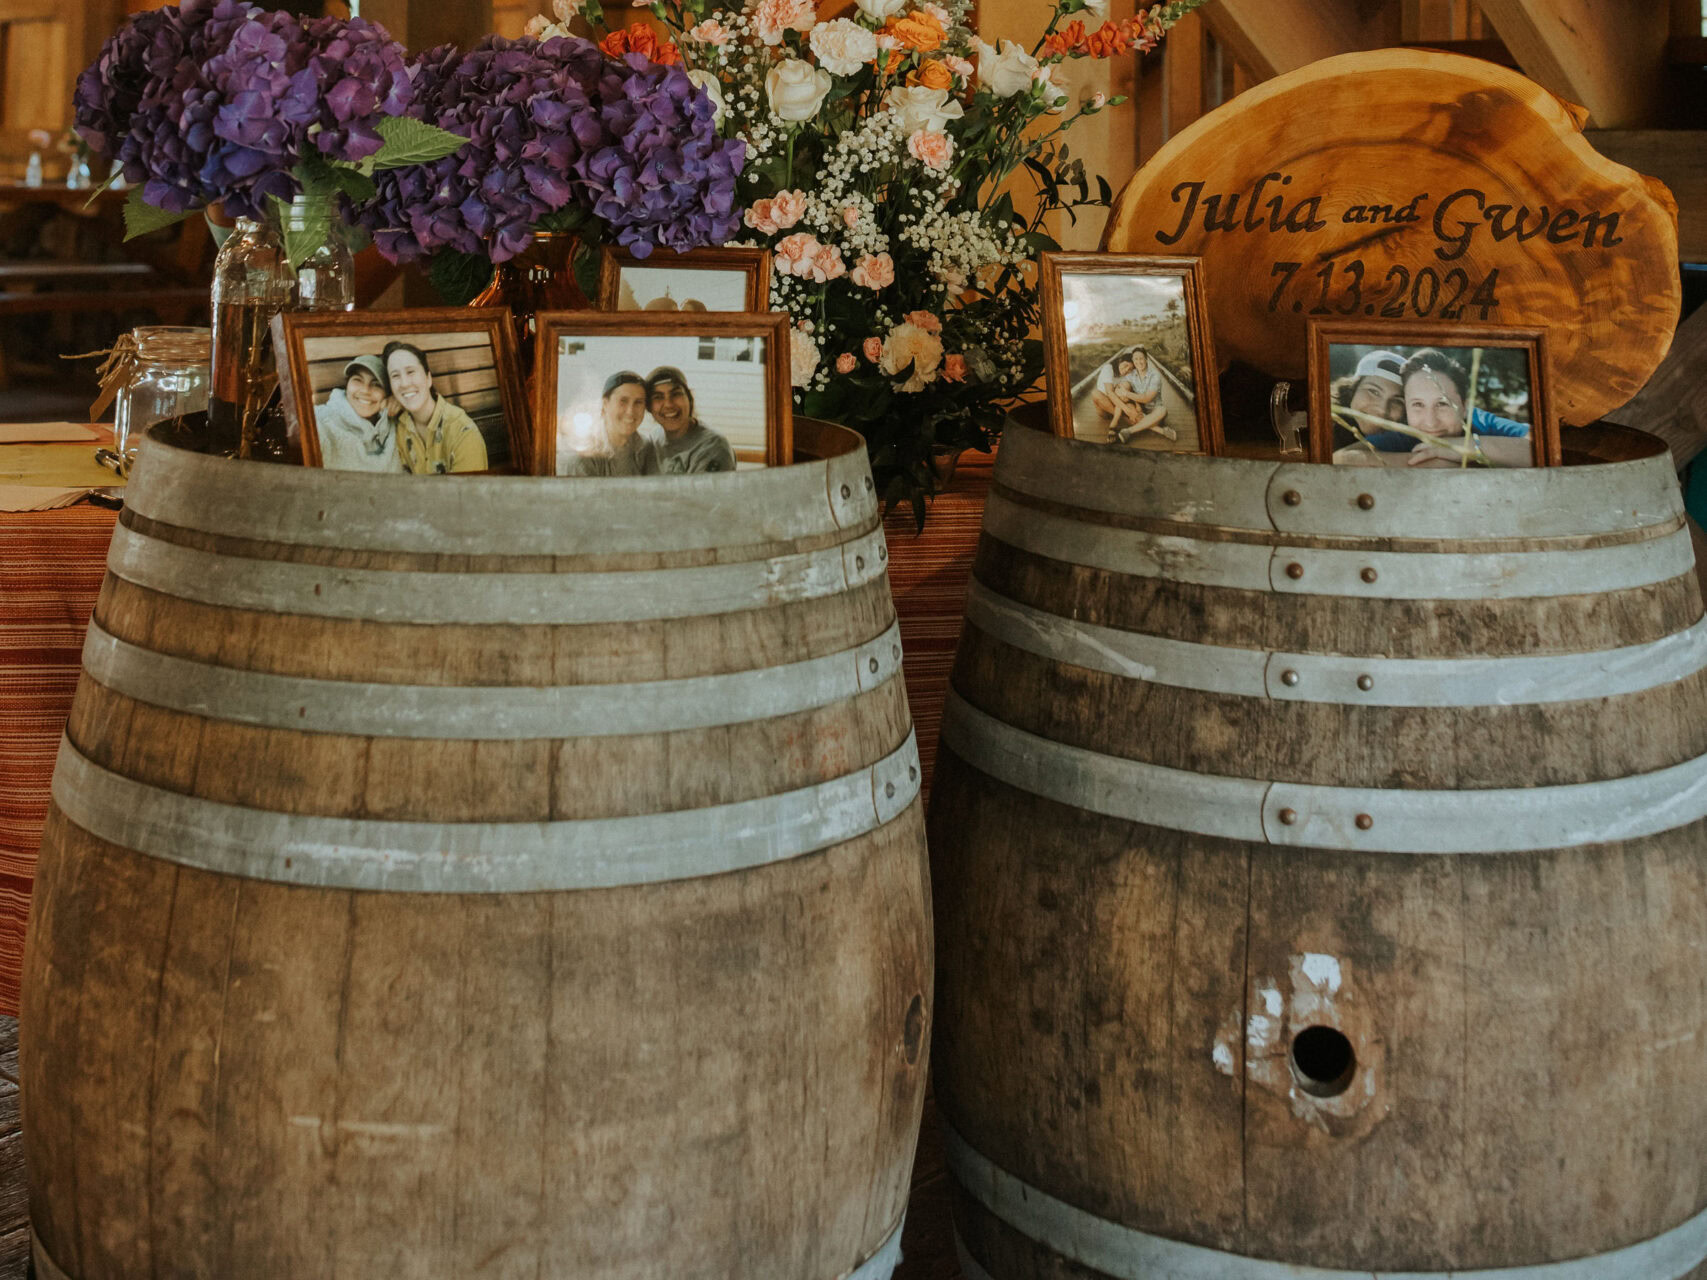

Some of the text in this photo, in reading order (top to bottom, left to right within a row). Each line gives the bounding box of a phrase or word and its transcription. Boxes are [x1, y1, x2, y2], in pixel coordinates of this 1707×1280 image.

[1155, 173, 1623, 260] Julia and Gwen
[1269, 260, 1500, 319] 7.13.2024
